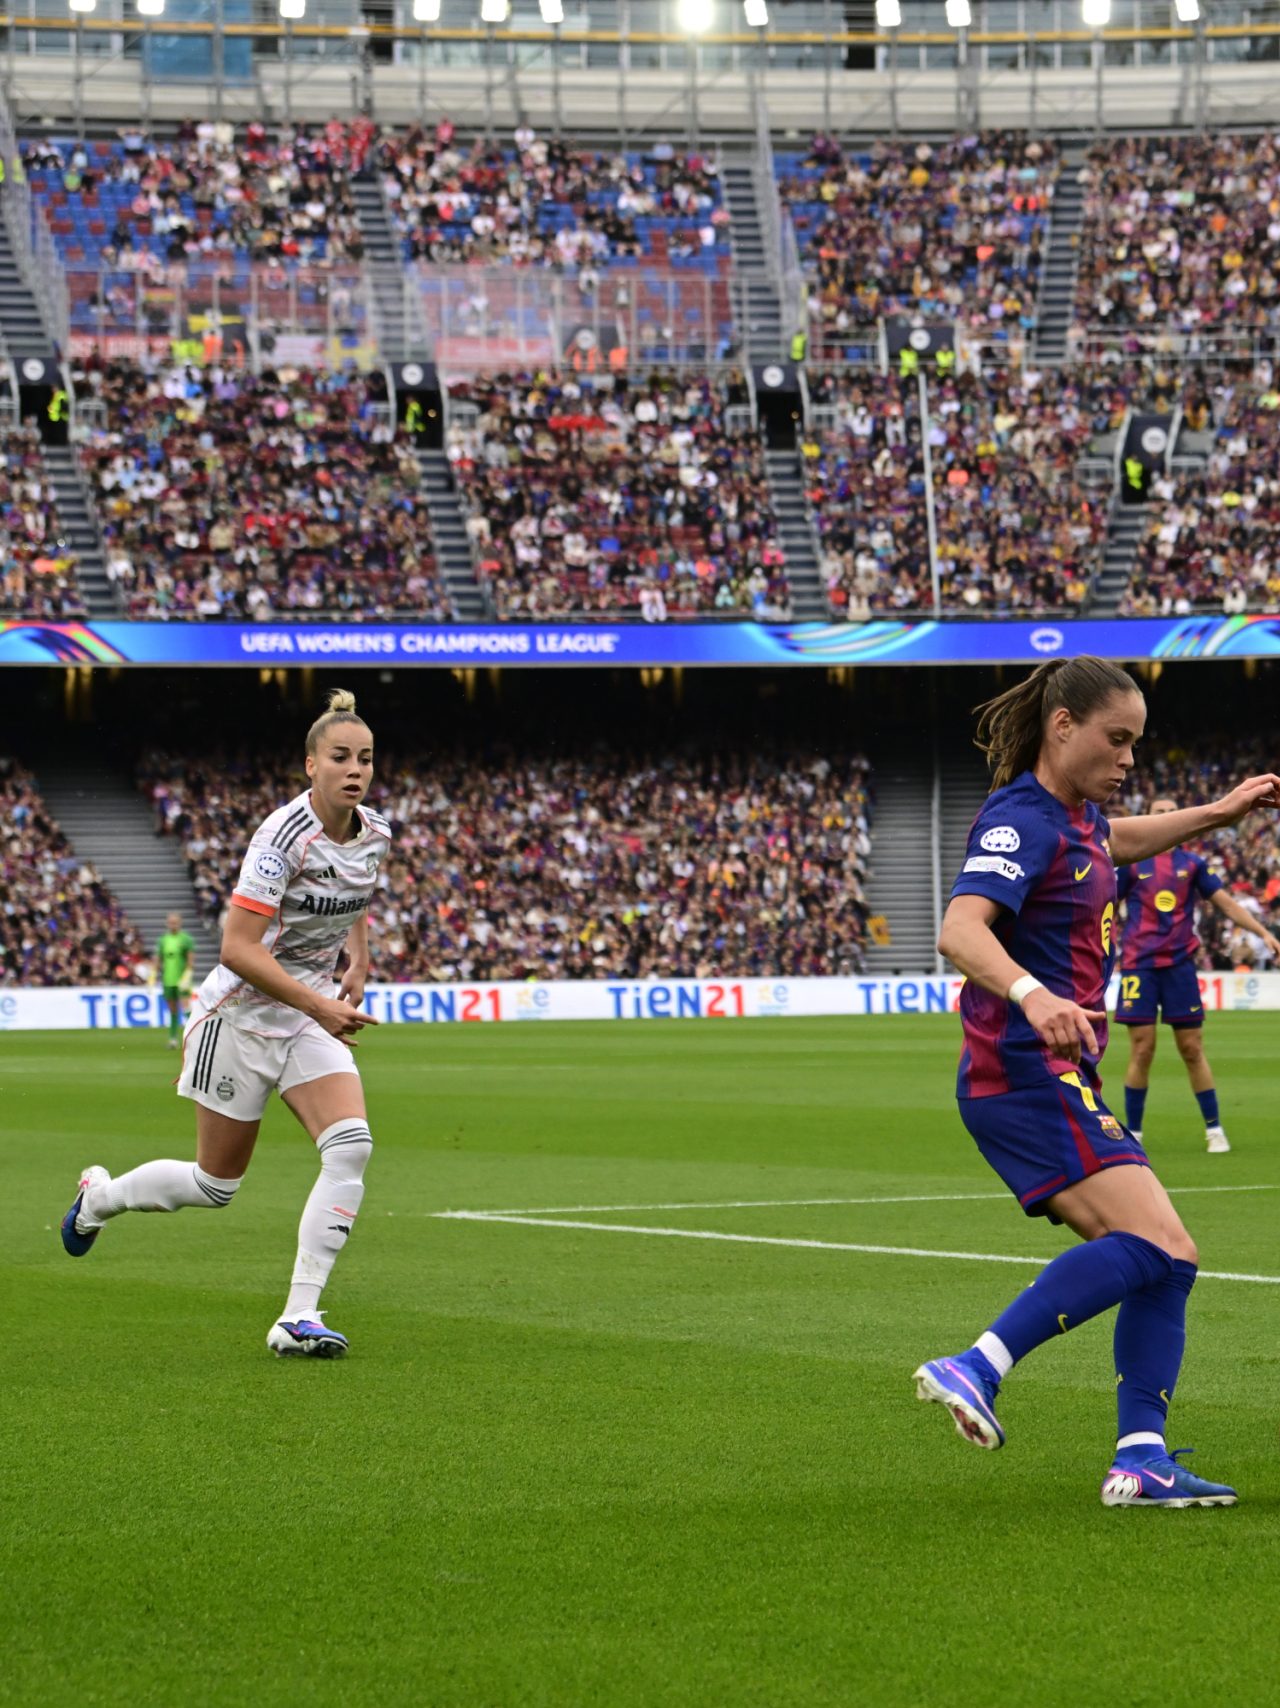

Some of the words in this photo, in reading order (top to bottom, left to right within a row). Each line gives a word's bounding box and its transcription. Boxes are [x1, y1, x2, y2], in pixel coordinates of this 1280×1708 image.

[240, 633, 294, 653] UEFA
[400, 633, 530, 653] CHAMPIONS
[535, 633, 616, 653] LEAGUE
[1121, 975, 1141, 1000] 12
